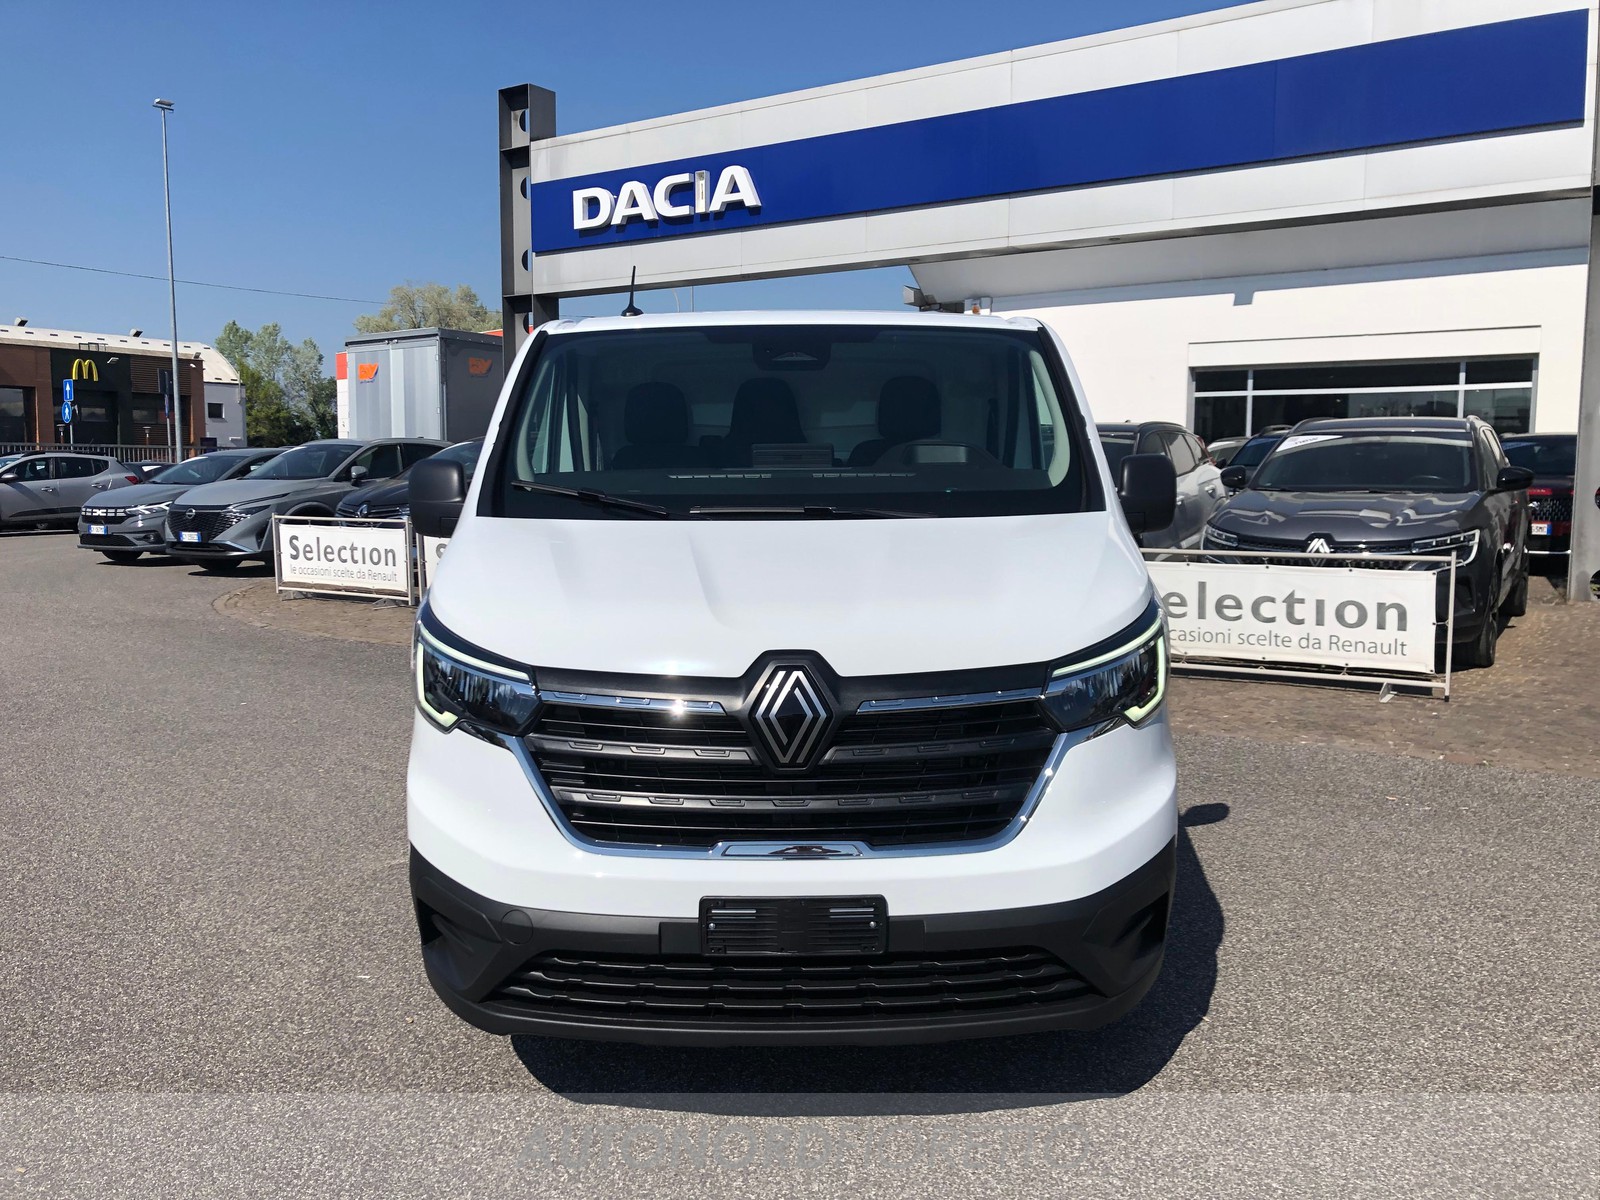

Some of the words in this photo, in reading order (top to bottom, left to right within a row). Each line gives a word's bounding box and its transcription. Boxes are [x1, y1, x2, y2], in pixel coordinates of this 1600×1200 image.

[573, 165, 761, 230] DACIA
[289, 535, 396, 566] Selection
[299, 566, 332, 578] occasioni
[333, 567, 355, 579] scelte
[356, 569, 366, 580] da
[368, 569, 398, 582] Renault
[1162, 581, 1407, 631] election
[1238, 630, 1292, 647] scelte
[1298, 633, 1321, 649] da
[1329, 635, 1407, 656] Renault
